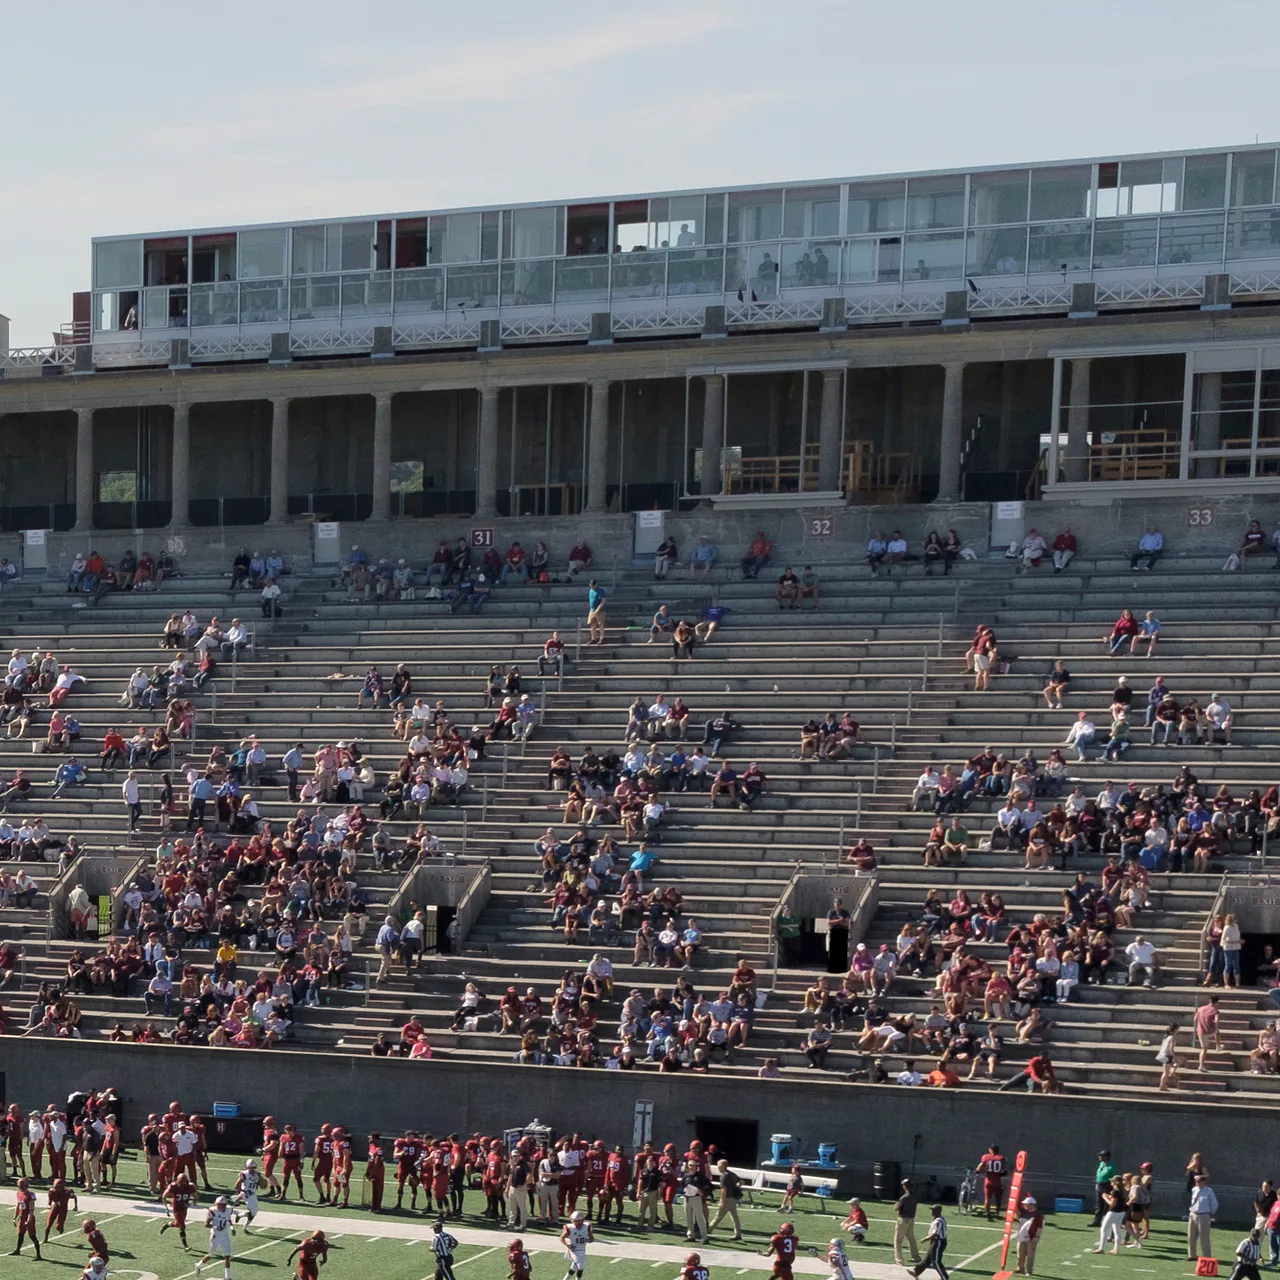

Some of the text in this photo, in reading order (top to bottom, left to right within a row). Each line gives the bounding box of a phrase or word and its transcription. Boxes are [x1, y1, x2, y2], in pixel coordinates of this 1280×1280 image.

[1191, 509, 1212, 524] 33
[812, 519, 831, 534] 32
[474, 530, 492, 545] 31
[592, 1161, 603, 1169] 21
[986, 1160, 1003, 1173] 10
[782, 1239, 793, 1253] 3
[523, 1256, 529, 1268] 3
